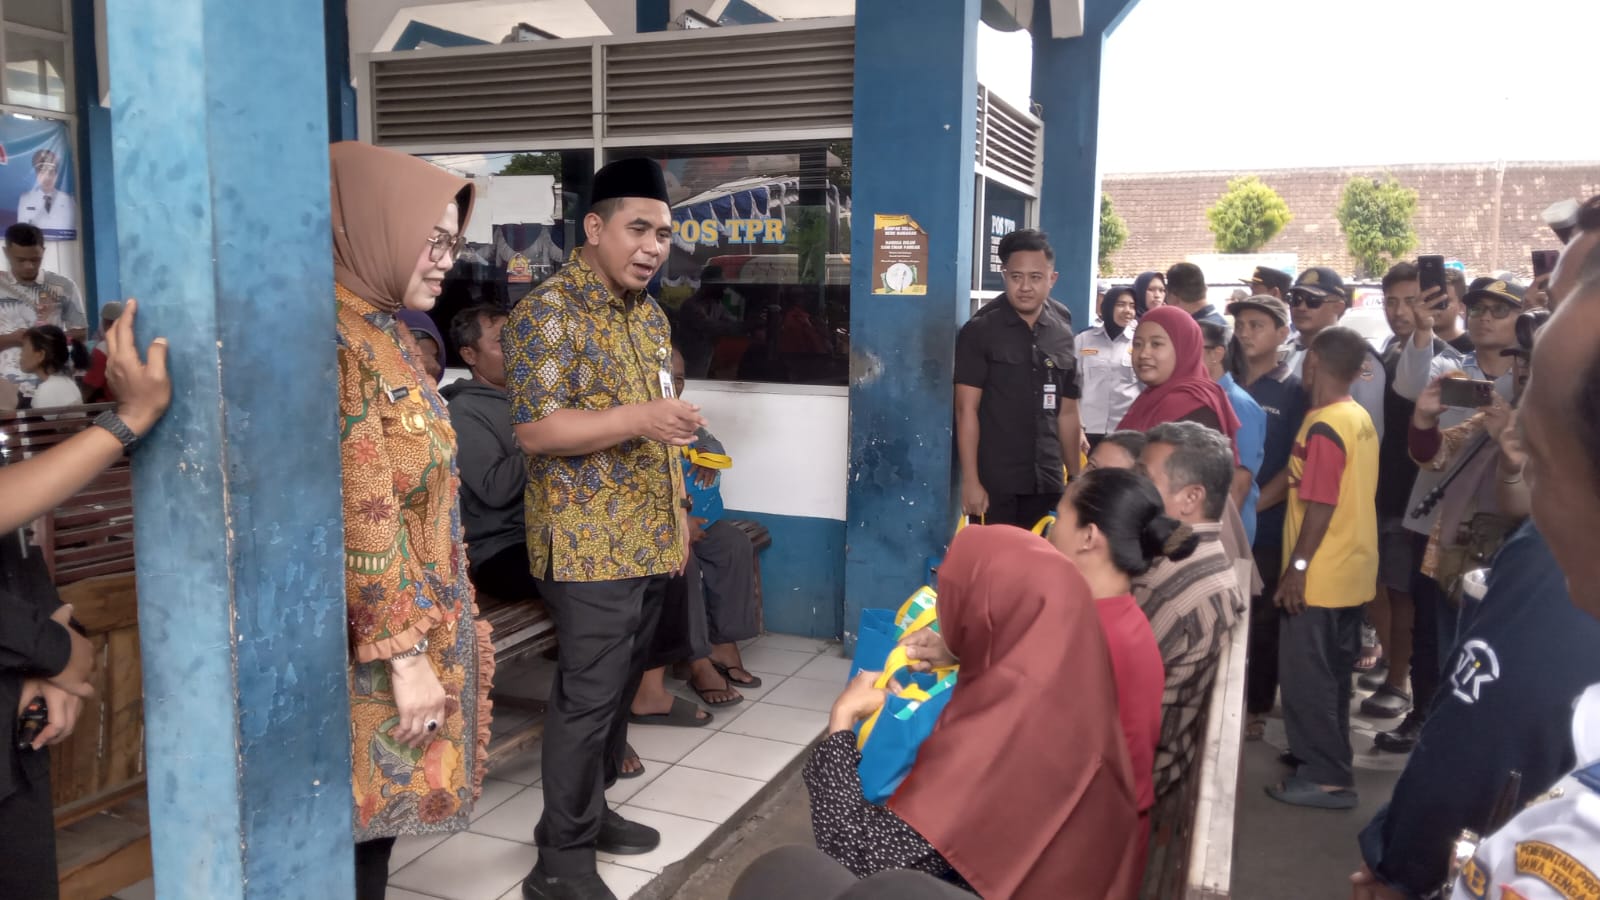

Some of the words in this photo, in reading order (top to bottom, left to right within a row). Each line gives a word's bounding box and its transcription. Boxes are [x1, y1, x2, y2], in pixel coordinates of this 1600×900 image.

[671, 219, 719, 243] POS
[725, 218, 786, 244] TPR
[991, 214, 1004, 236] POS
[1004, 217, 1016, 235] TPR
[1575, 871, 1600, 894] PRO
